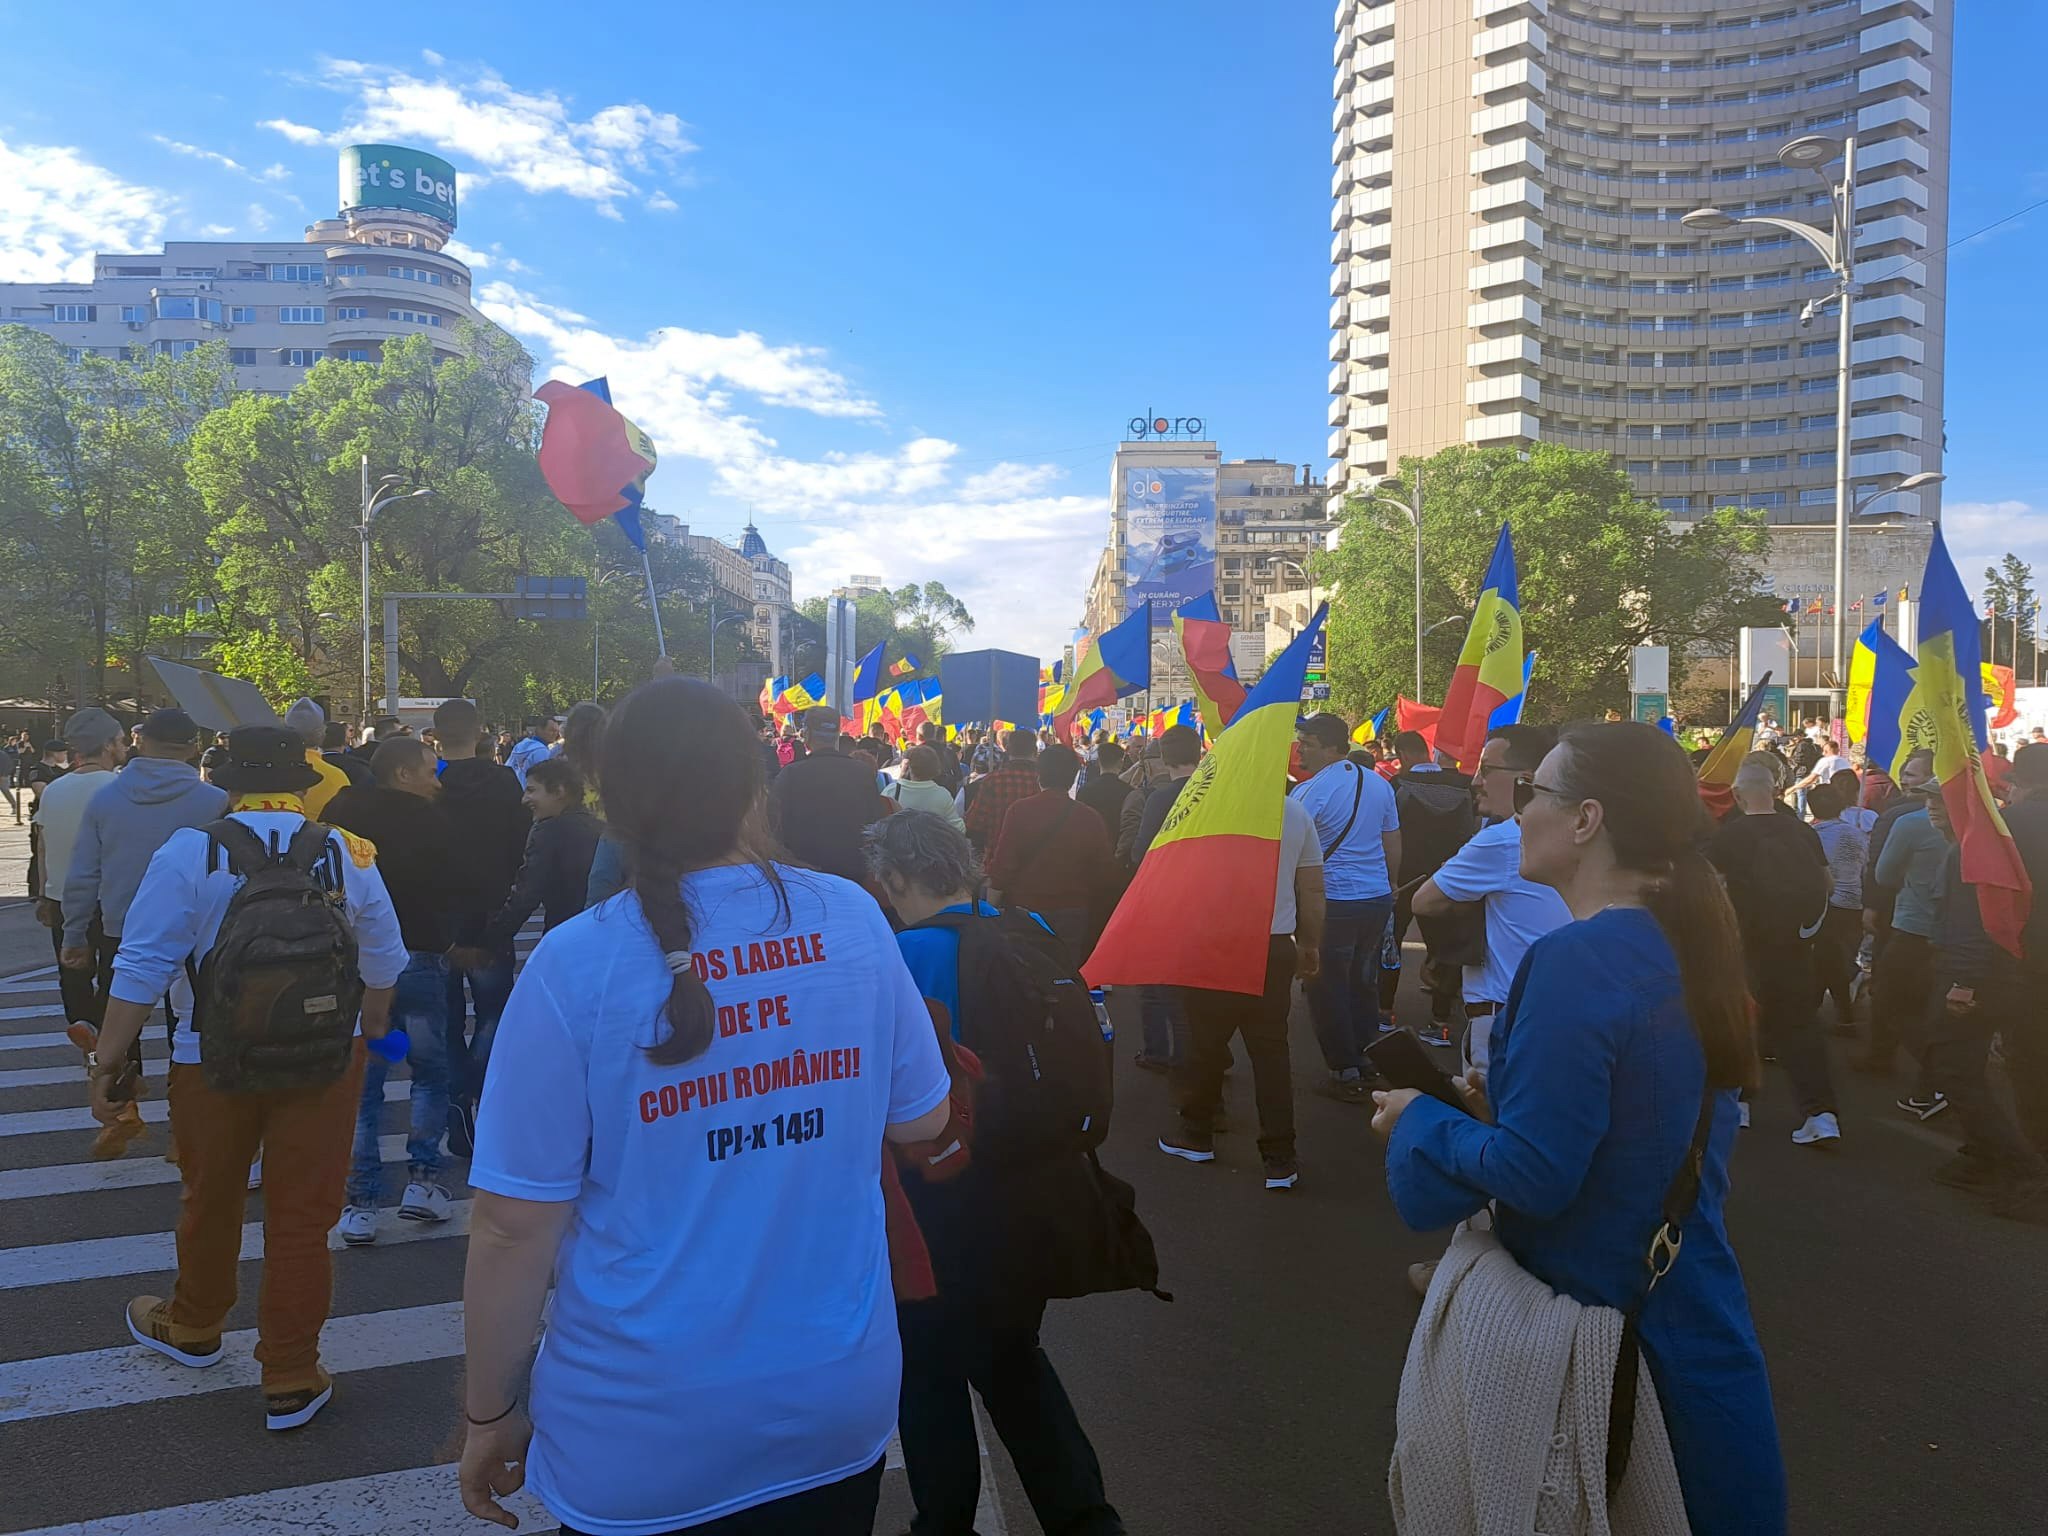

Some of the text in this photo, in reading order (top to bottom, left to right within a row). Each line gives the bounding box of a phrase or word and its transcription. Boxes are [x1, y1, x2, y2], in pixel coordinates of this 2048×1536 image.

[1131, 407, 1203, 439] glo.ro
[1133, 474, 1163, 498] glo
[691, 933, 826, 983] OS LABELE
[719, 995, 791, 1038] DE PE
[639, 1047, 861, 1124] COPIII ROMÂNIEI!
[771, 1107, 824, 1146] 145)
